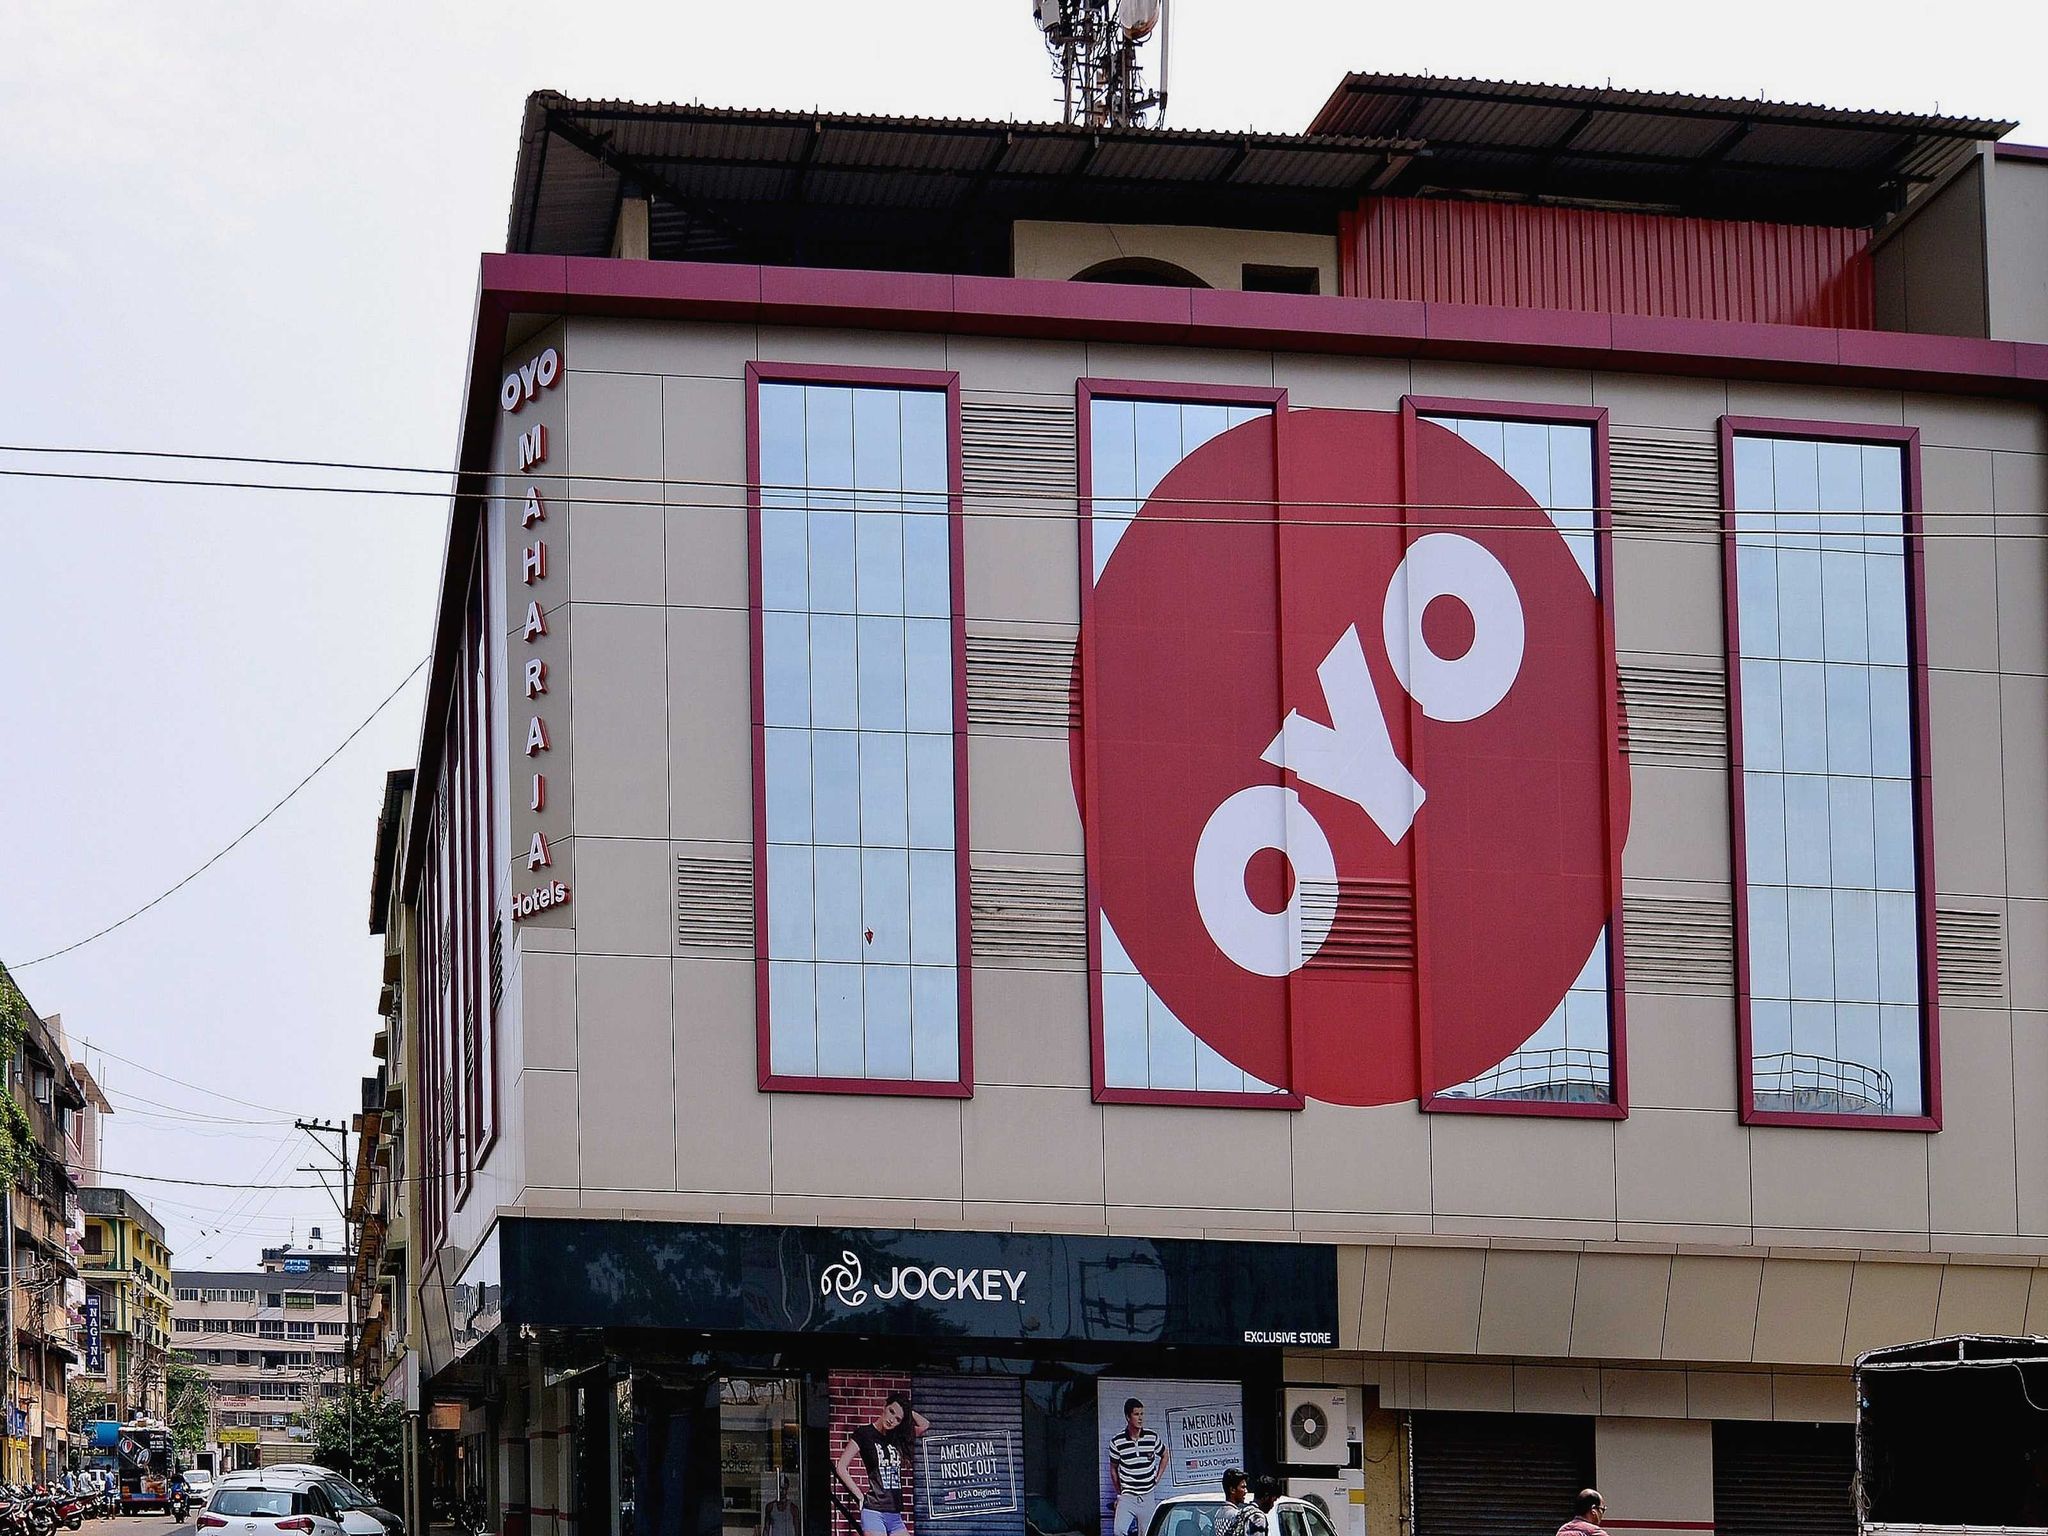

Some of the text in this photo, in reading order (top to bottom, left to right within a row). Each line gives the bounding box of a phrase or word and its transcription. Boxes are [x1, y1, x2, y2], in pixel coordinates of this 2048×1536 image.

[501, 348, 560, 412] OYO
[518, 423, 551, 871] MAHARAJA
[1193, 533, 1525, 978] OYO
[511, 880, 569, 920] Hotels
[873, 1266, 1027, 1301] JOCKEY
[89, 1308, 99, 1366] NAGINA
[1244, 1331, 1332, 1344] EXCLUSIVE STORE
[1182, 1412, 1234, 1431] AMERICANA
[1182, 1428, 1236, 1448] INSIDE OUT
[940, 1441, 996, 1461] AMERICANA
[940, 1458, 997, 1479] INSIDE OUT
[1199, 1459, 1214, 1467] USA
[957, 1487, 1001, 1499] USA Originals
